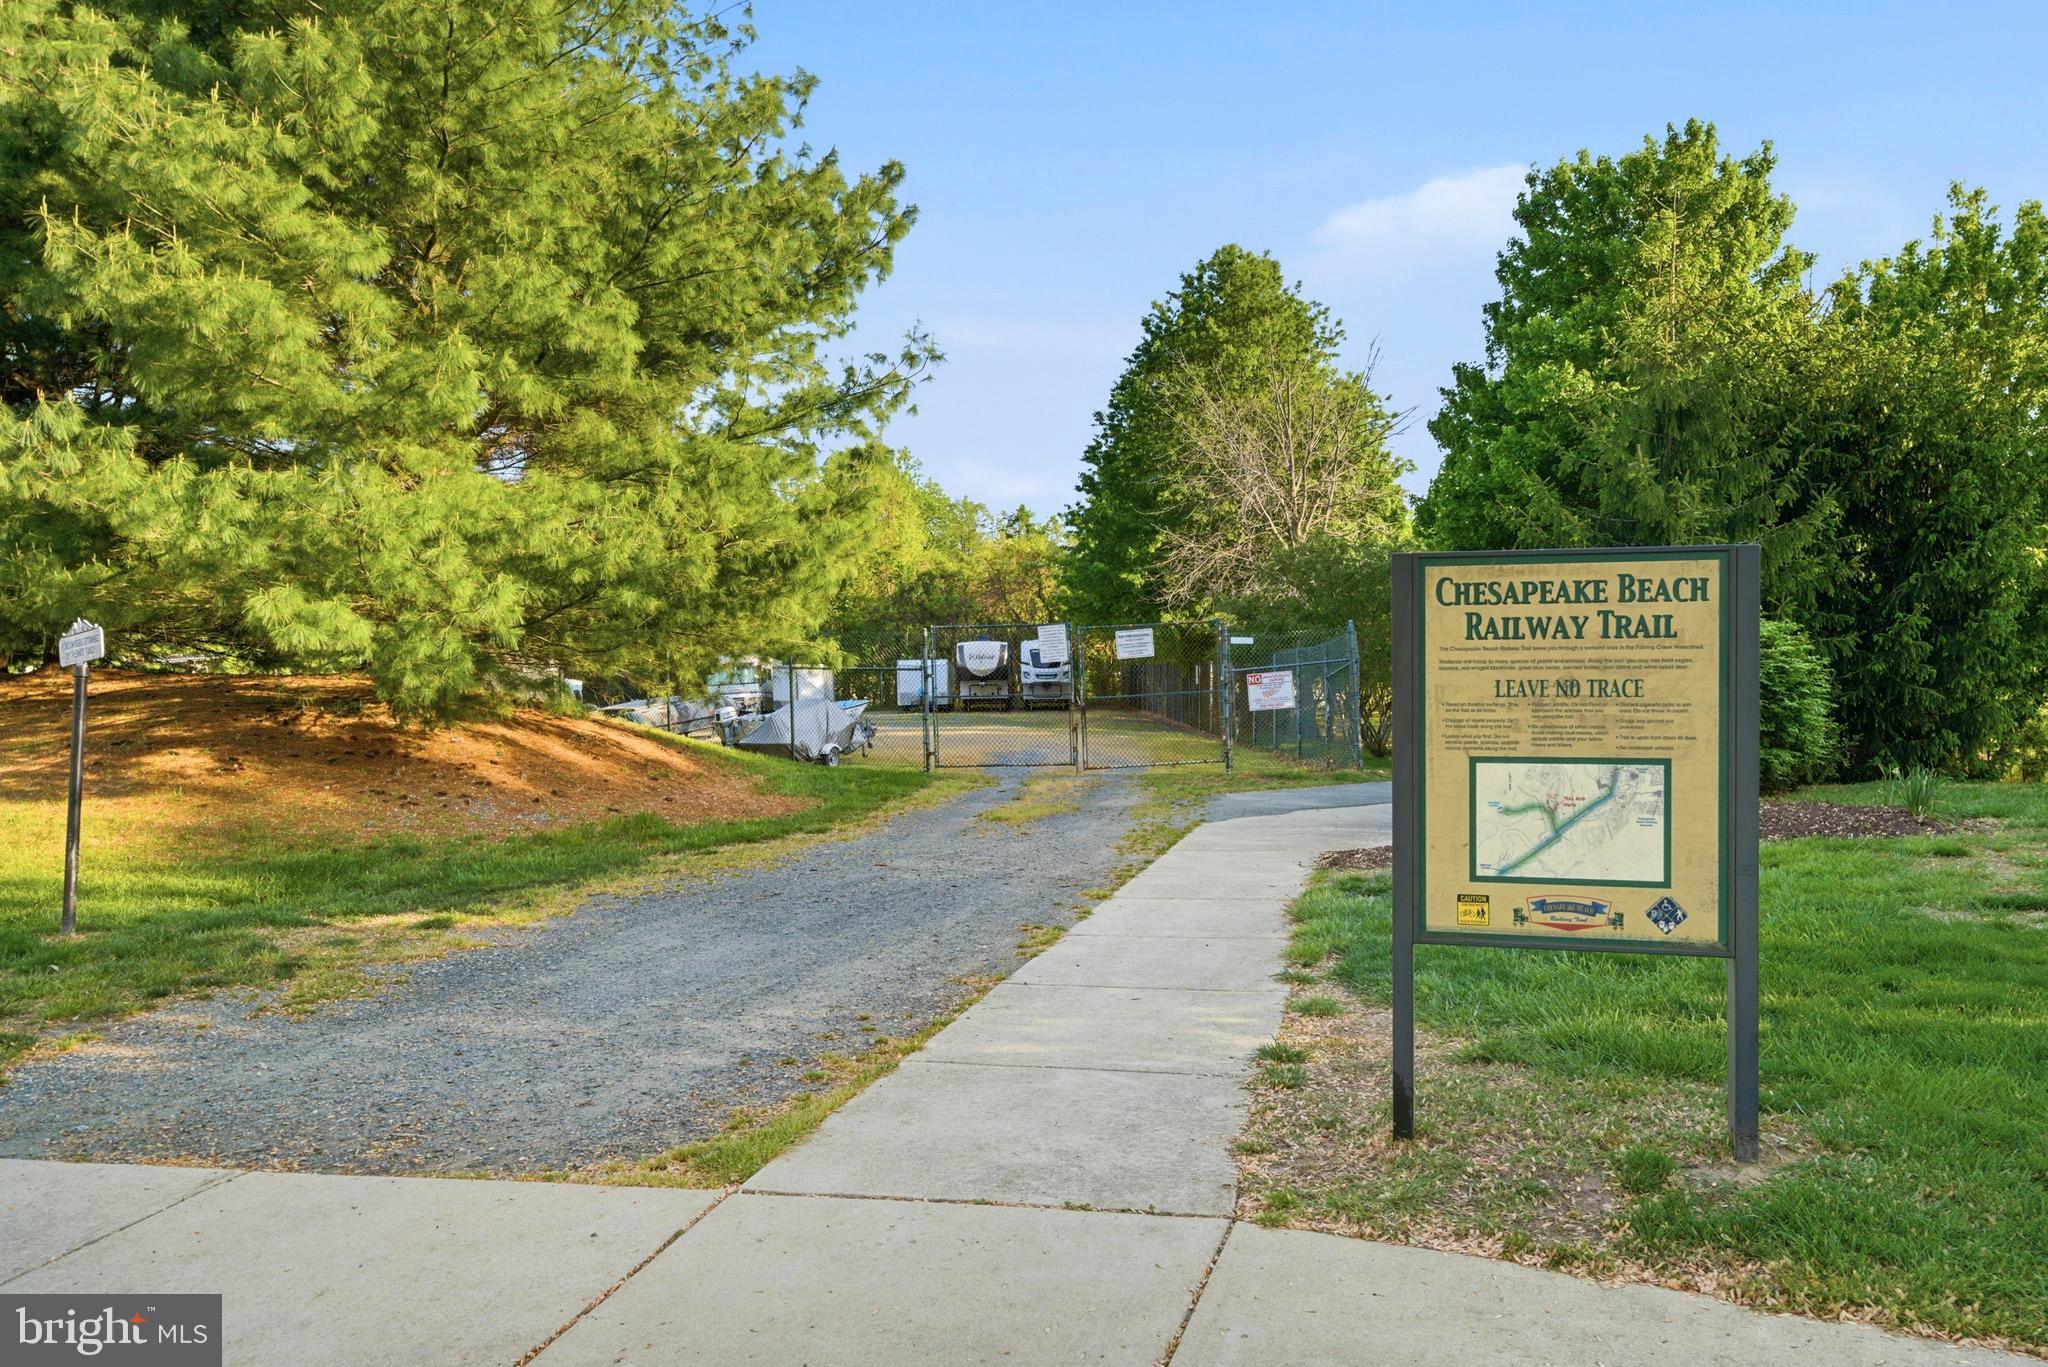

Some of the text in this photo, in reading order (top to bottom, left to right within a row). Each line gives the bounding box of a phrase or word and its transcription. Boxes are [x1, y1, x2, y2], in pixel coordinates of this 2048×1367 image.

[1436, 574, 1710, 606] CHESAPEAKE BEACH
[1464, 610, 1678, 640] RAILWAY TRAIL
[1248, 676, 1262, 684] NO
[1495, 678, 1644, 698] LEAVE NO TRACE
